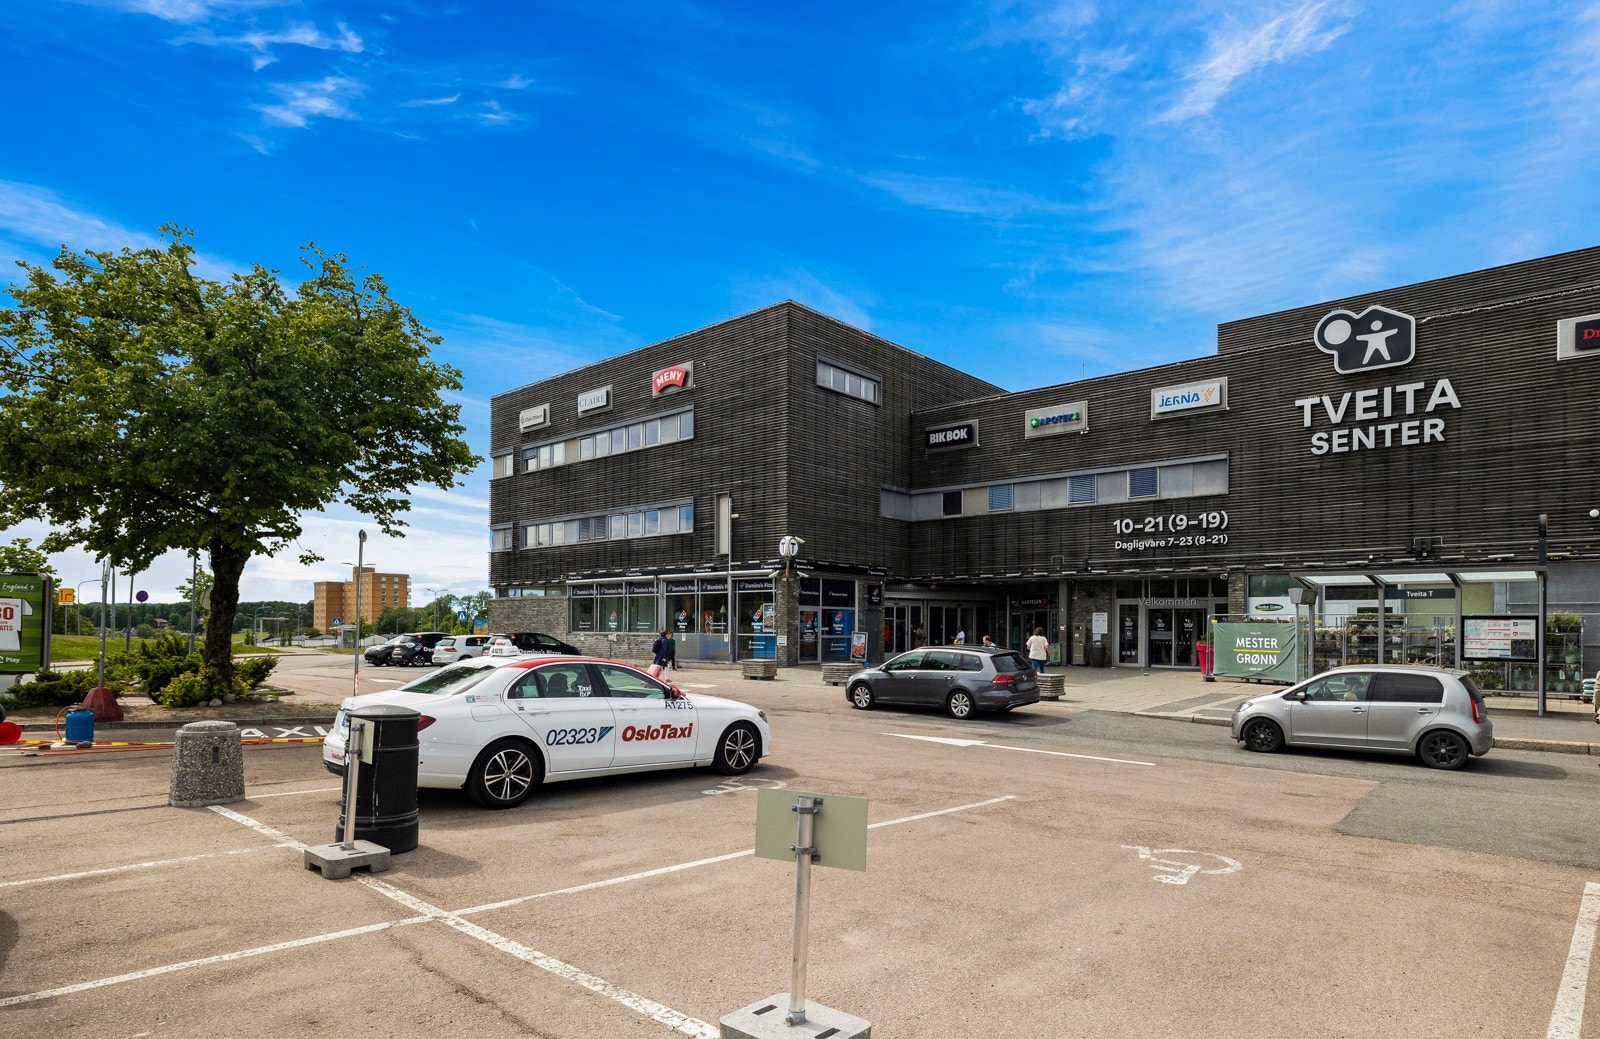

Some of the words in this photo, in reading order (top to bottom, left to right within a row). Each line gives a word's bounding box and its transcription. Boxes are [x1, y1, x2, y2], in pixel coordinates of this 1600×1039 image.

[656, 371, 682, 387] MENY
[579, 395, 605, 408] CLAIRE
[1295, 378, 1462, 428] TVEITA
[1039, 413, 1073, 426] APOTEK
[929, 432, 946, 444] BIK
[946, 428, 968, 442] BOK
[1310, 418, 1445, 455] SENTER
[1113, 516, 1164, 534] 10-21
[1168, 510, 1229, 533] (9-19)
[1115, 539, 1166, 551] Dagligvare
[1168, 536, 1193, 547] 7-23
[1195, 533, 1228, 546] (8-21)
[1138, 597, 1198, 607] Velkommen
[0, 606, 14, 620] 0
[1236, 637, 1278, 649] MESTER
[5, 656, 20, 664] Play
[1236, 653, 1277, 665] GRØNN
[577, 684, 591, 692] Taxi
[665, 701, 694, 710] A1275
[546, 727, 597, 746] 02323
[621, 722, 694, 742] OsloTaxi
